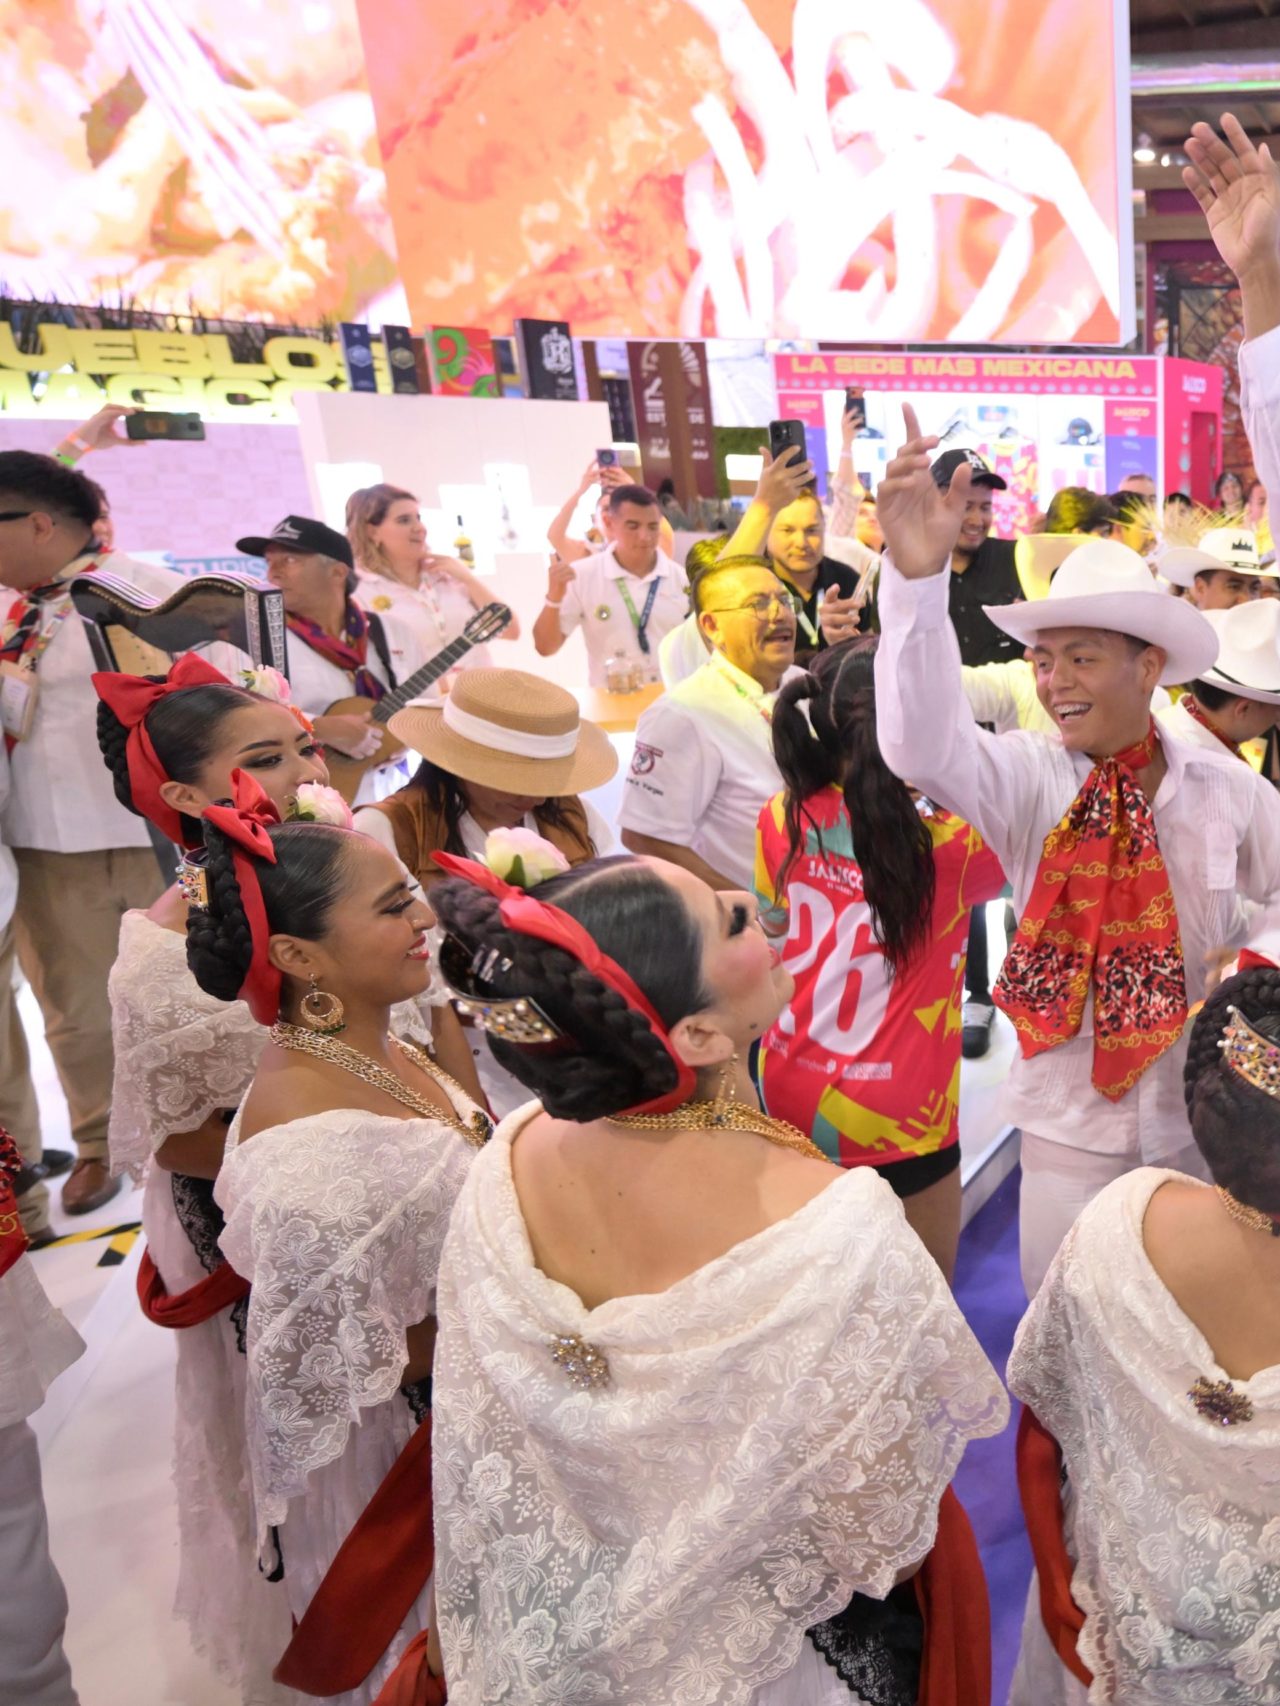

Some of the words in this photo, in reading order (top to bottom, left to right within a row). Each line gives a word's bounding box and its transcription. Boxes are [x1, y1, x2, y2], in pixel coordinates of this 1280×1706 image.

[791, 356, 829, 375] LA
[833, 357, 907, 376] SEDE
[982, 358, 1137, 379] MEXICANA
[778, 881, 896, 1056] 26
